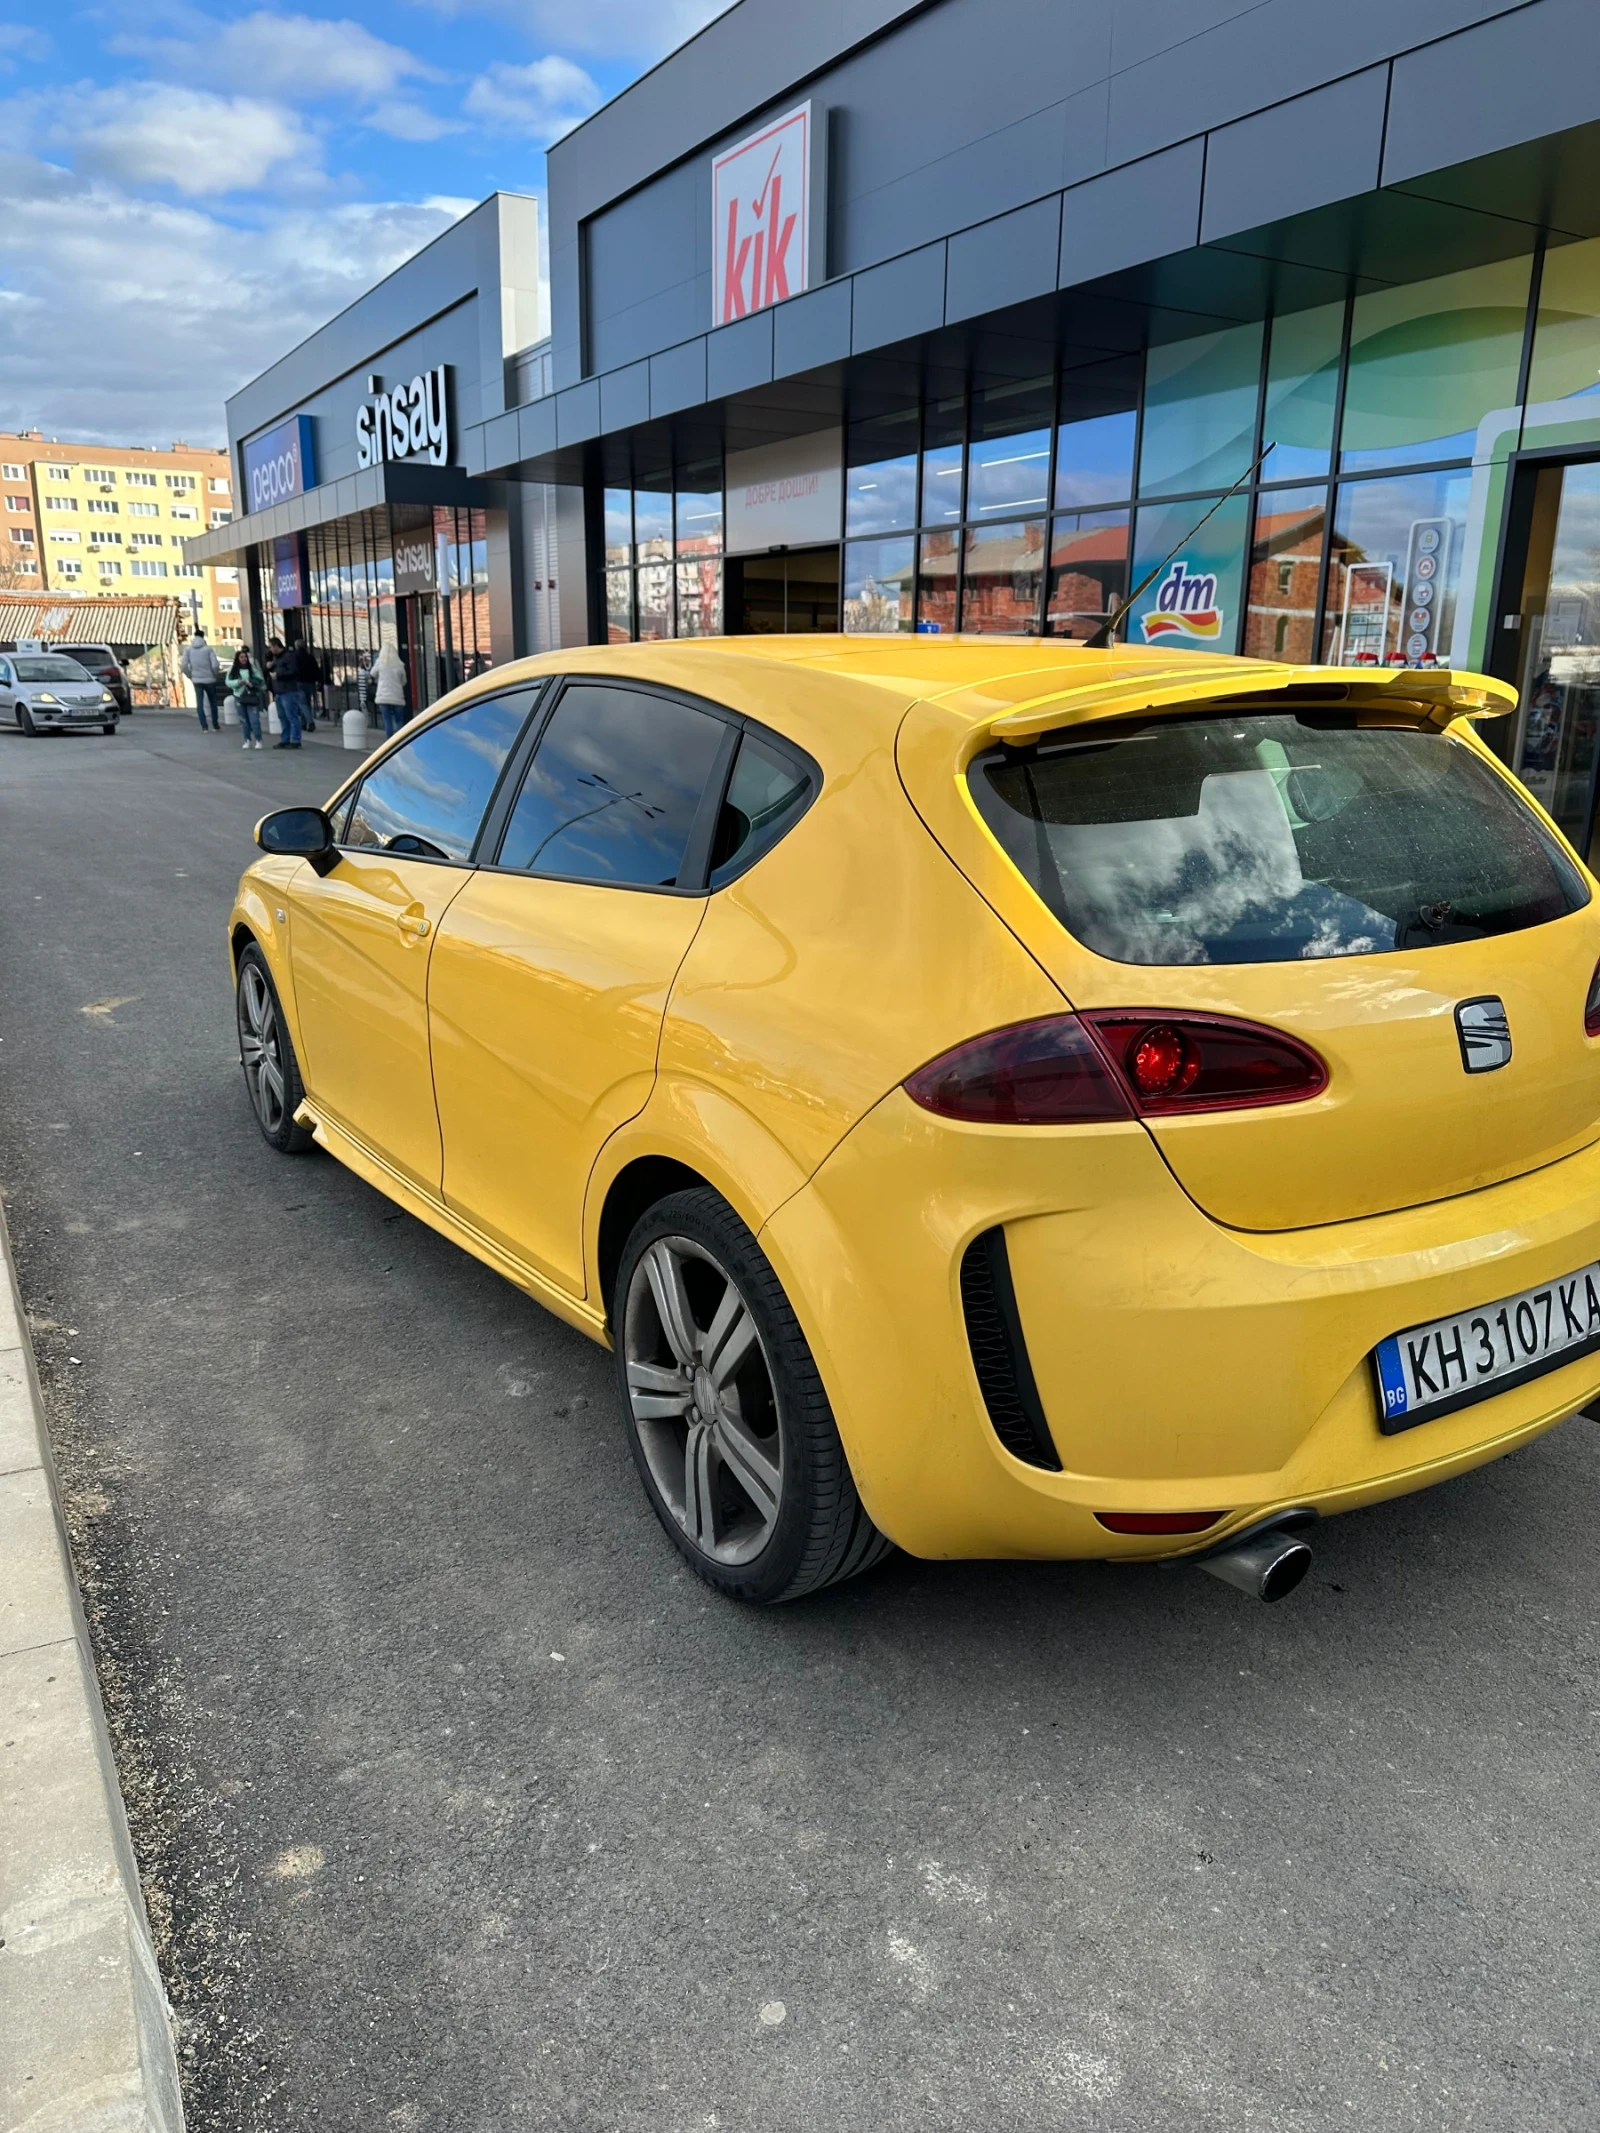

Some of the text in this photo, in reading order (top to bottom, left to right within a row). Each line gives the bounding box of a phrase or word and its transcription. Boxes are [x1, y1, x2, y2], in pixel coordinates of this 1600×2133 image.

[723, 143, 798, 324] kik
[356, 364, 448, 470] sinsay
[252, 451, 295, 512] pepco
[745, 475, 819, 511] ДОБРЕ ДОШЛИ!
[395, 540, 432, 582] sinsay
[277, 573, 298, 596] pepco
[1158, 565, 1214, 612] dm
[1386, 1386, 1405, 1408] BG
